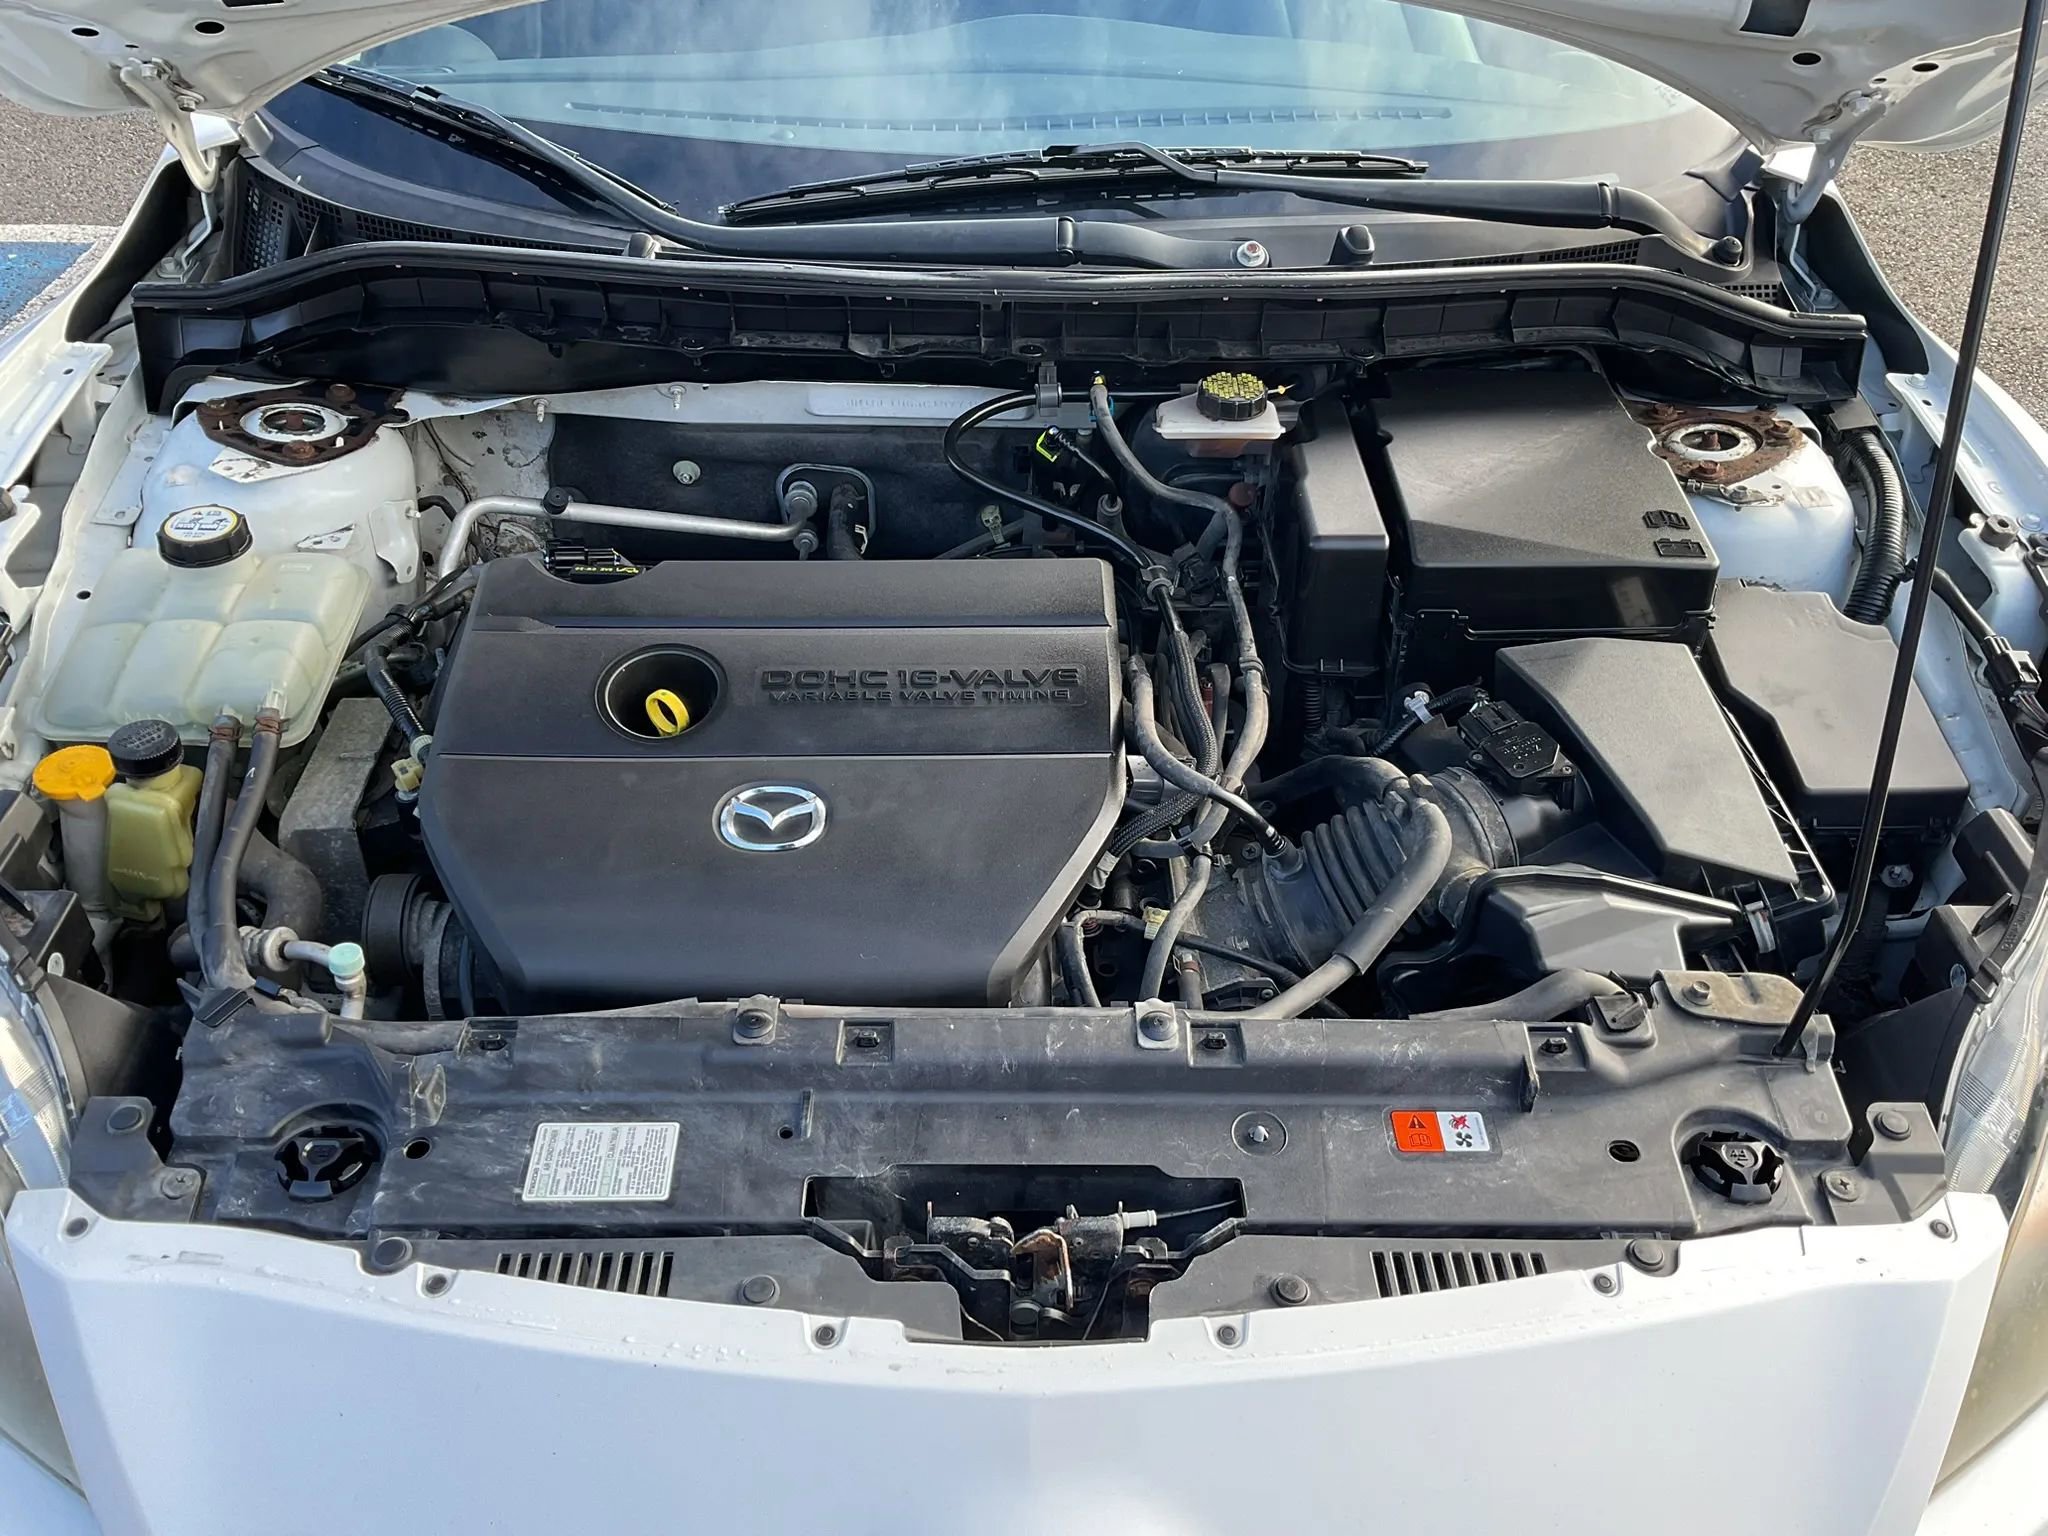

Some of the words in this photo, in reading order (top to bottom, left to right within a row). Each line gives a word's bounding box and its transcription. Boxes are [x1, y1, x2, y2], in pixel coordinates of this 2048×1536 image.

[761, 670, 889, 690] DOHC
[897, 668, 1080, 690] 16-VALVE
[769, 690, 893, 703] VARIABLE
[899, 690, 977, 703] VALVE
[982, 689, 1071, 703] TIMING
